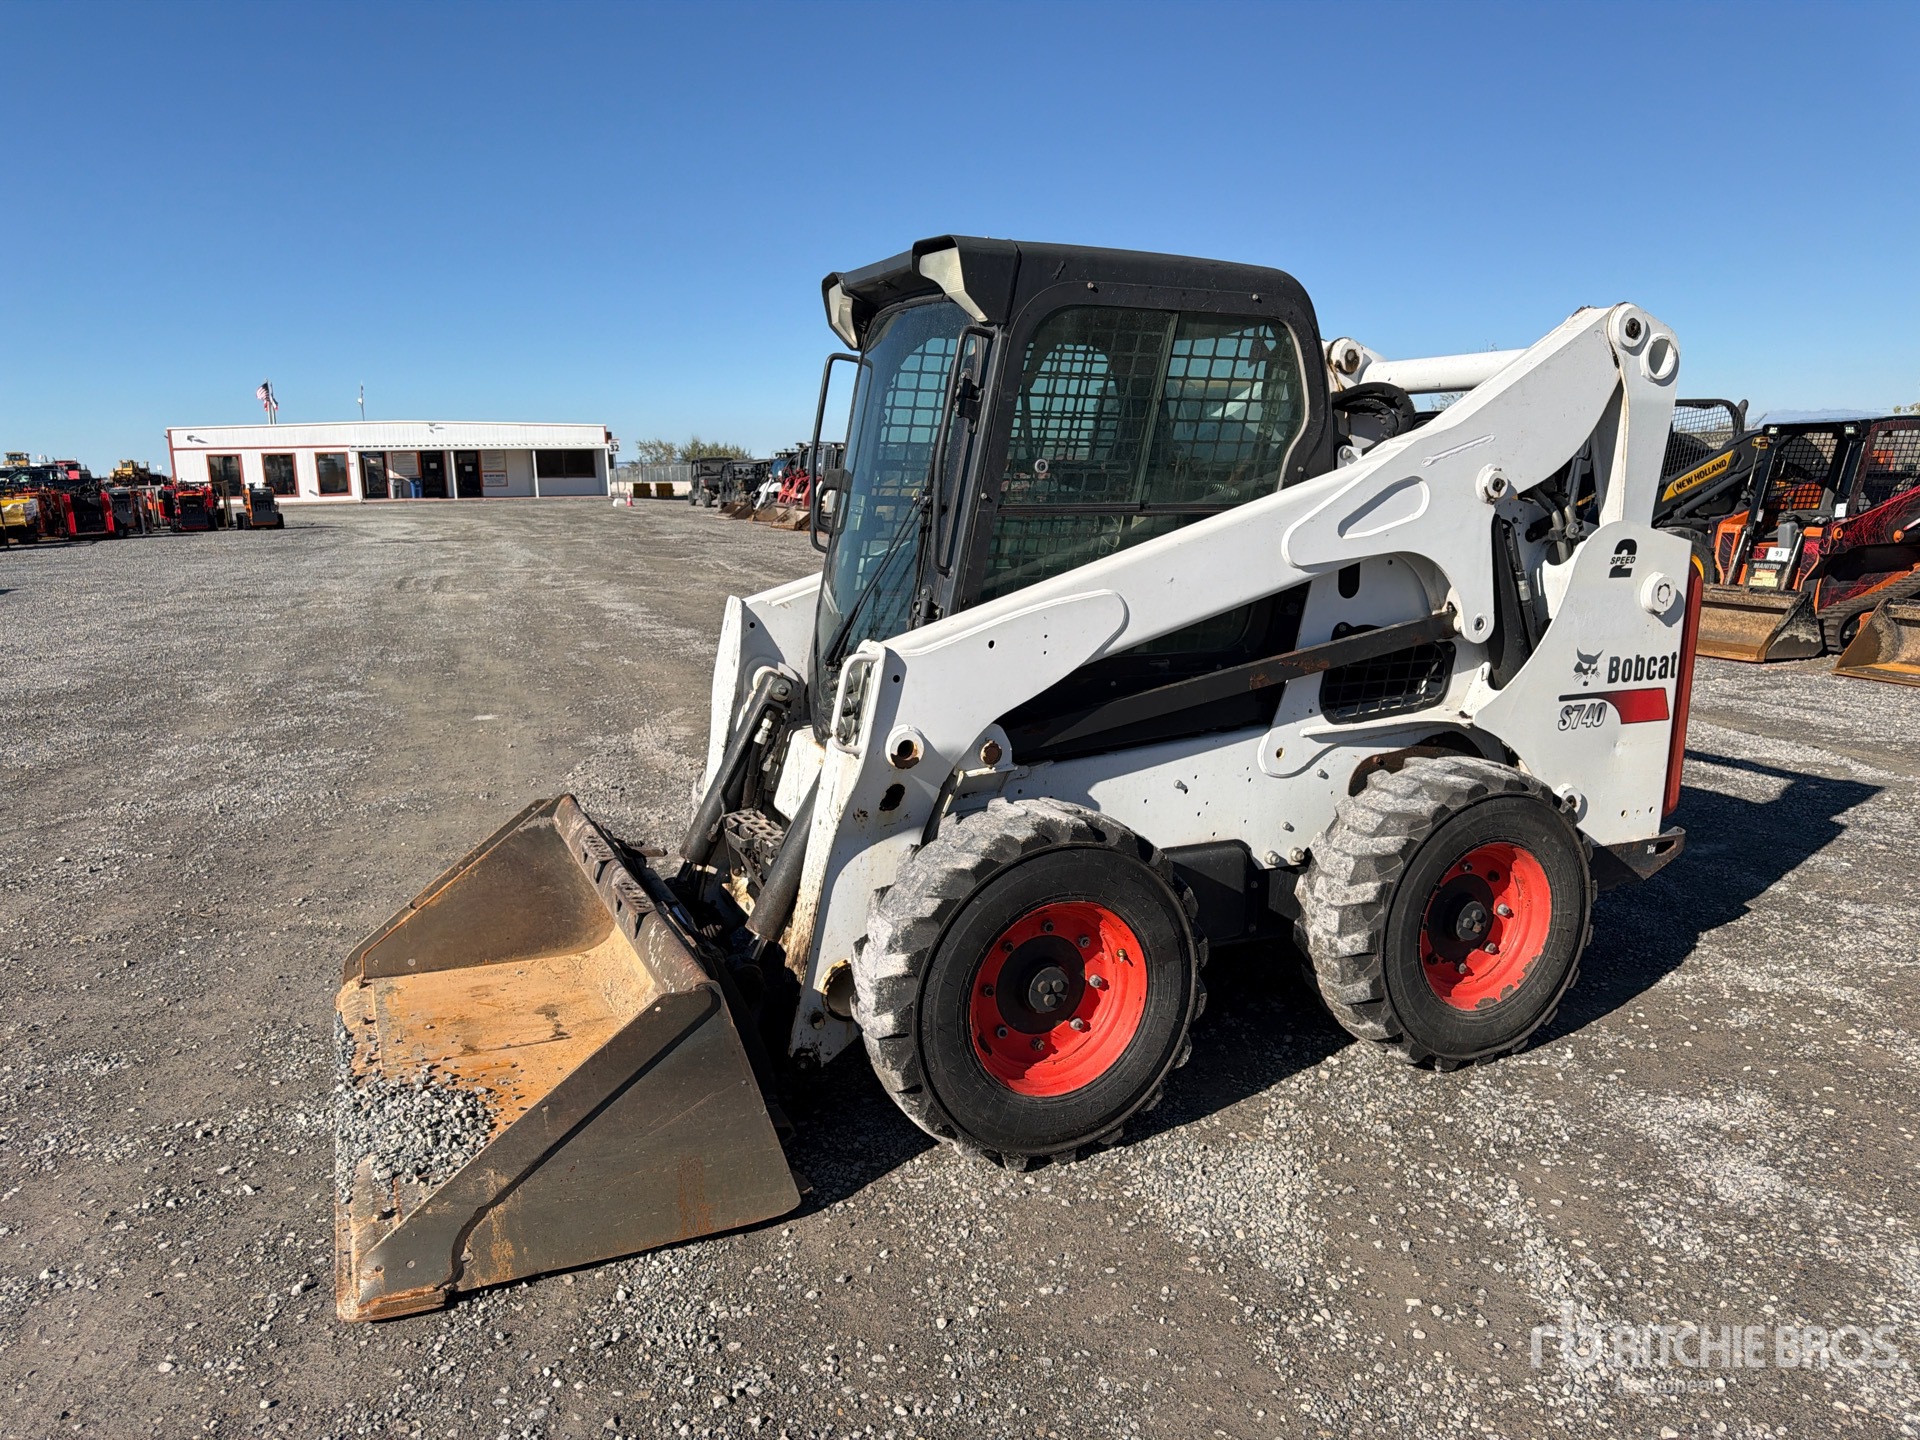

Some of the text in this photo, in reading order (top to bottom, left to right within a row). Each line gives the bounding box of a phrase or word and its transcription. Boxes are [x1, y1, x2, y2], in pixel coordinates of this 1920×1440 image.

[610, 444, 620, 452] 32
[1676, 476, 1694, 491] NEW
[1694, 459, 1727, 481] HOLLAND
[1608, 538, 1637, 578] 2
[1610, 556, 1636, 566] SPEED
[1753, 562, 1781, 570] MANITOU
[1607, 651, 1677, 684] Bobcat
[1558, 702, 1608, 731] S740
